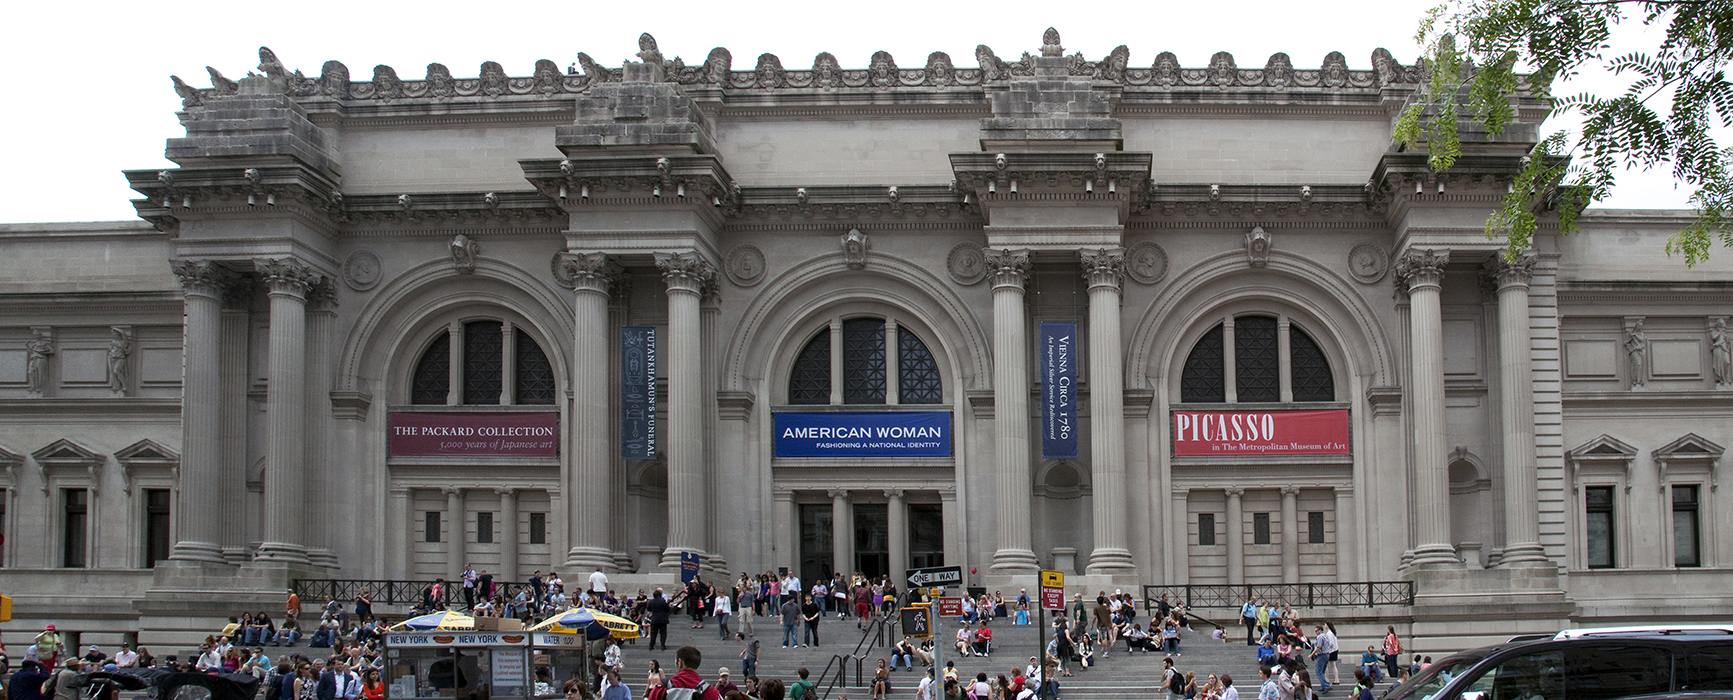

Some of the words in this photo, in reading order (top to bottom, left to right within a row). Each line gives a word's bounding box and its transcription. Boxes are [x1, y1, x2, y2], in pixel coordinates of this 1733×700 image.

[646, 330, 656, 412] TUTANKHAMUN'S
[394, 426, 418, 436] THE
[422, 426, 474, 436] PACKARD
[478, 426, 553, 436] COLLECTION
[782, 427, 872, 438] AMERICAN
[876, 426, 941, 438] WOMAN
[1058, 412, 1070, 440] 1780
[1176, 413, 1275, 442] PICASSO
[647, 415, 656, 458] FUNERAL
[439, 440, 462, 450] 5,000
[465, 441, 487, 450] years
[489, 439, 500, 450] of
[500, 440, 538, 451] Japanese
[539, 441, 553, 449] art
[1222, 443, 1238, 451] The
[1239, 442, 1288, 452] Metropolitan
[1290, 442, 1322, 450] Museum
[1323, 442, 1332, 450] of
[1332, 442, 1346, 450] Art
[914, 574, 930, 582] ONE
[938, 572, 955, 580] WAY
[478, 635, 498, 643] YORK
[543, 636, 560, 644] WATER
